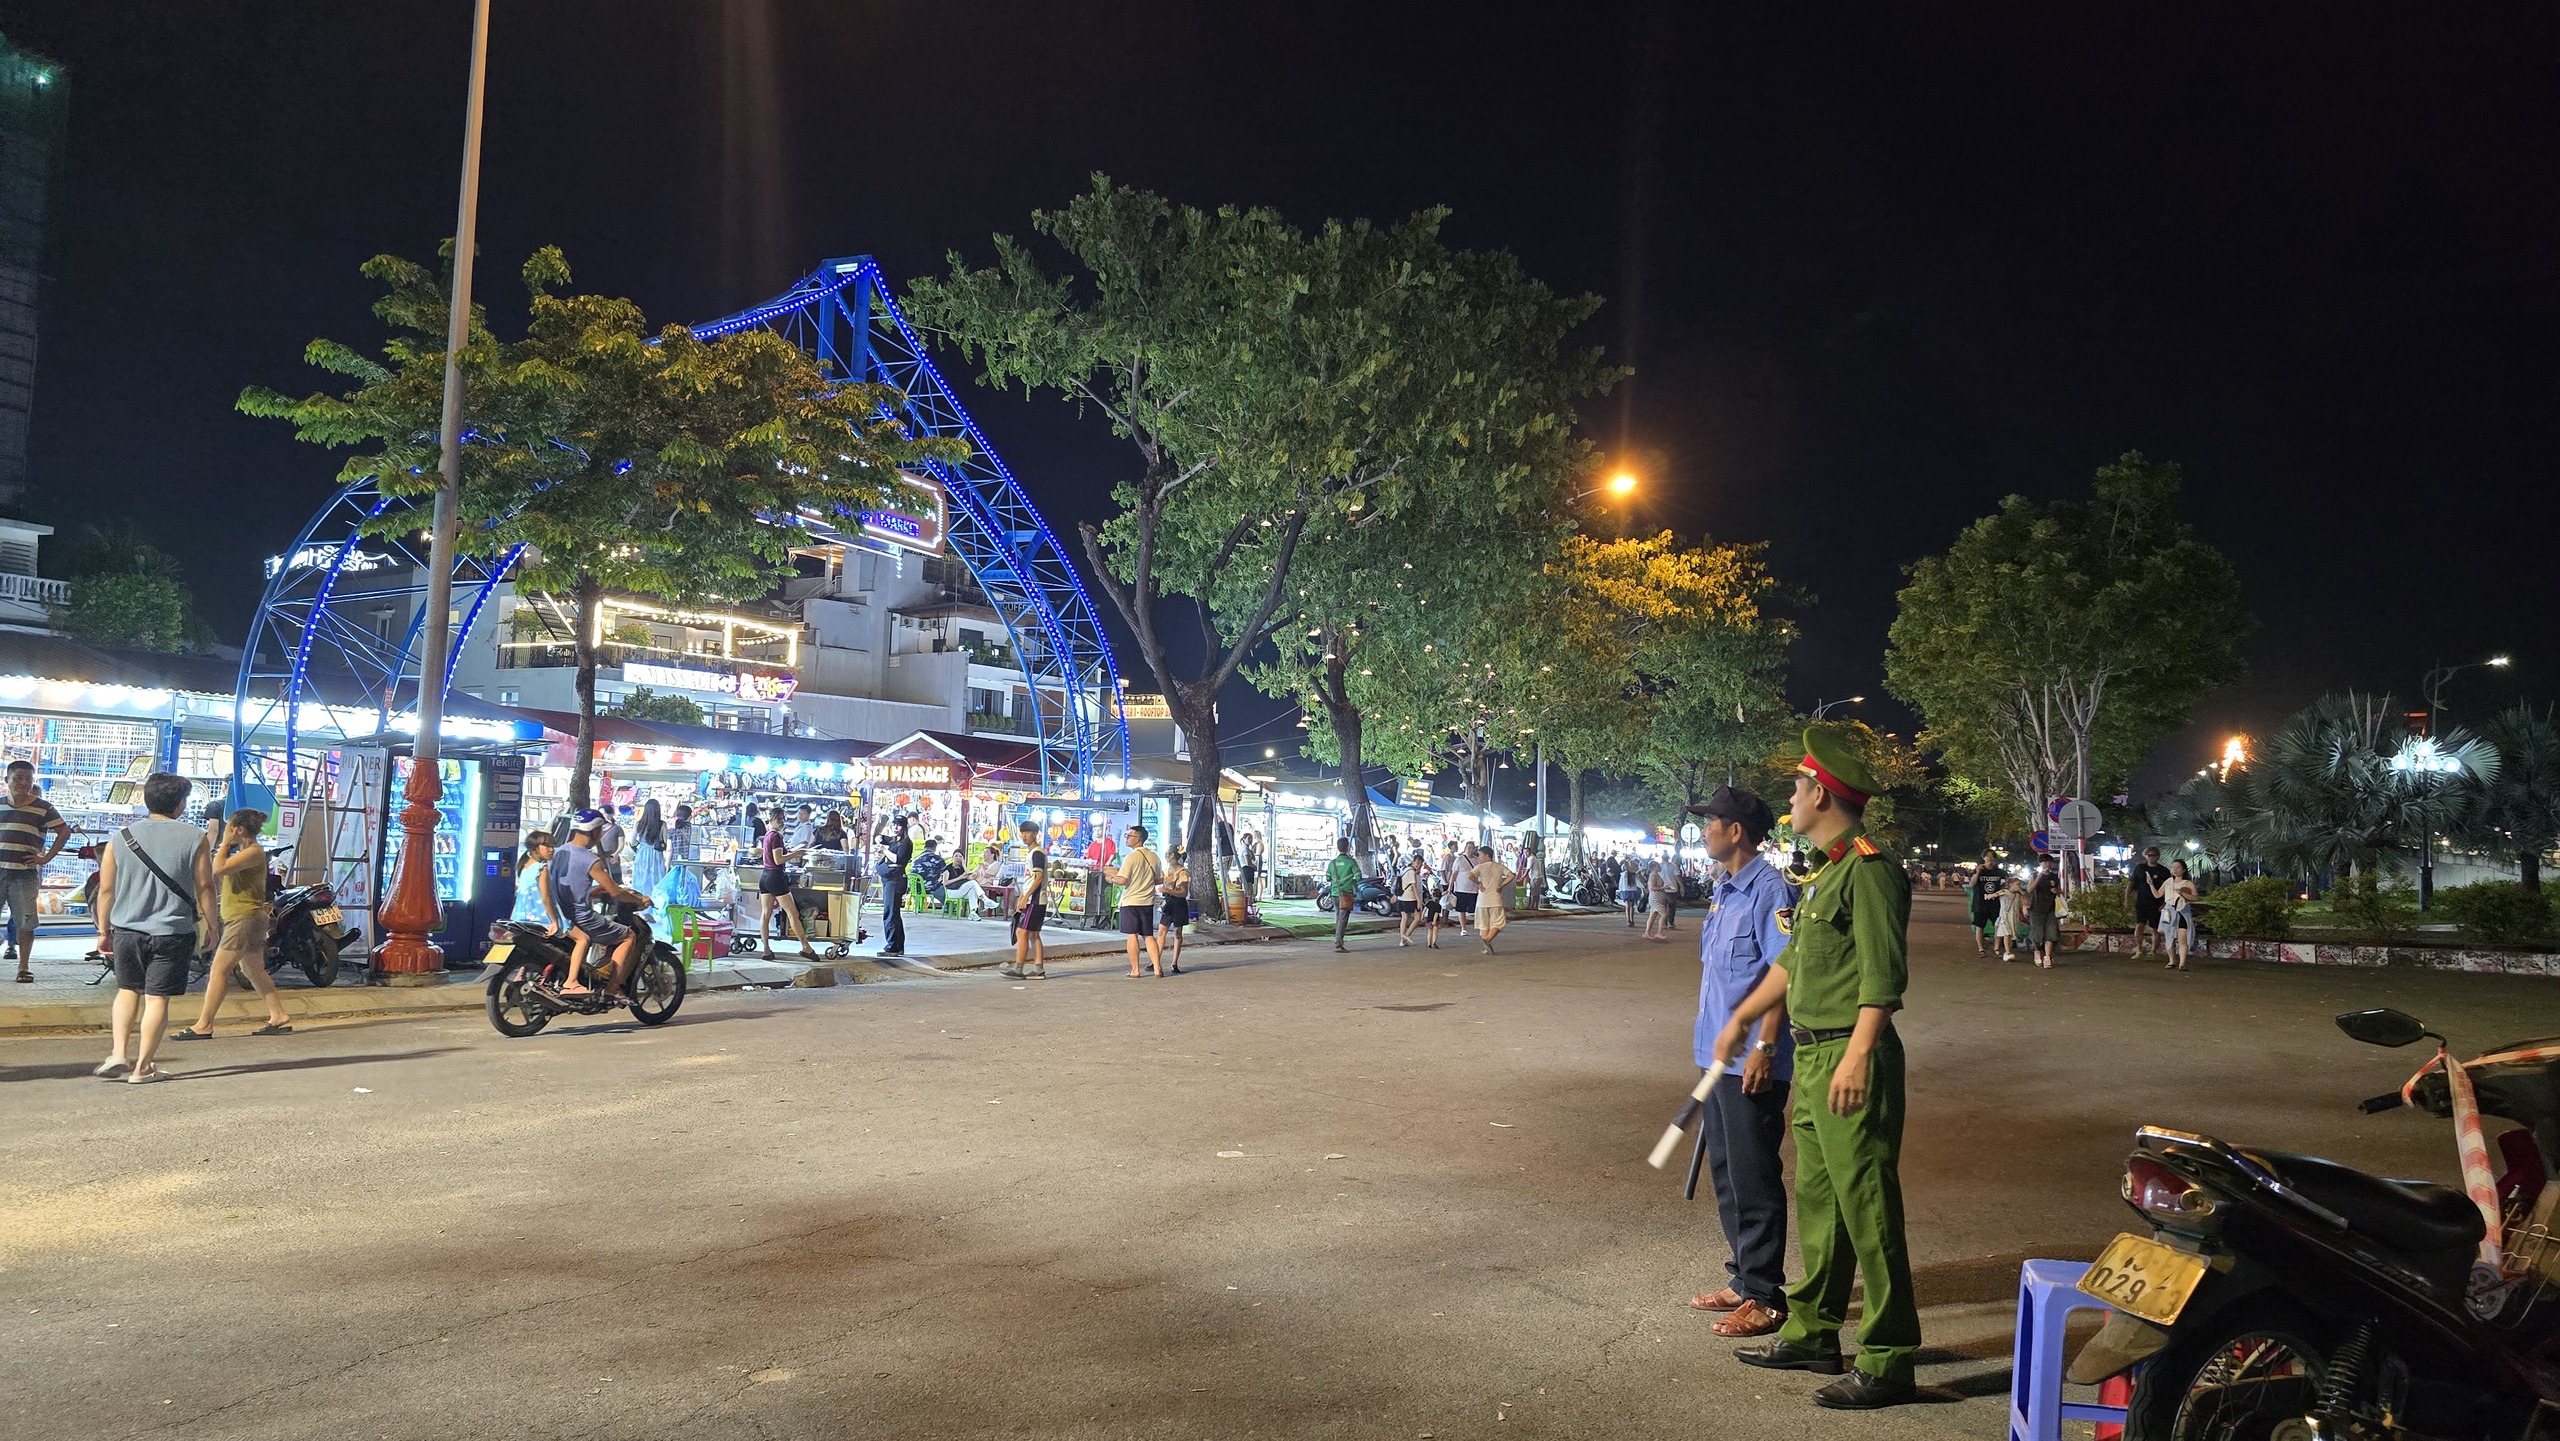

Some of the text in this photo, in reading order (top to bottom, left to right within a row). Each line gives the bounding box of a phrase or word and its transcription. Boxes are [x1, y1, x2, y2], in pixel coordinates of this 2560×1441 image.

[491, 758, 523, 767] Teklife
[865, 765, 950, 783] SEN MASSAGE
